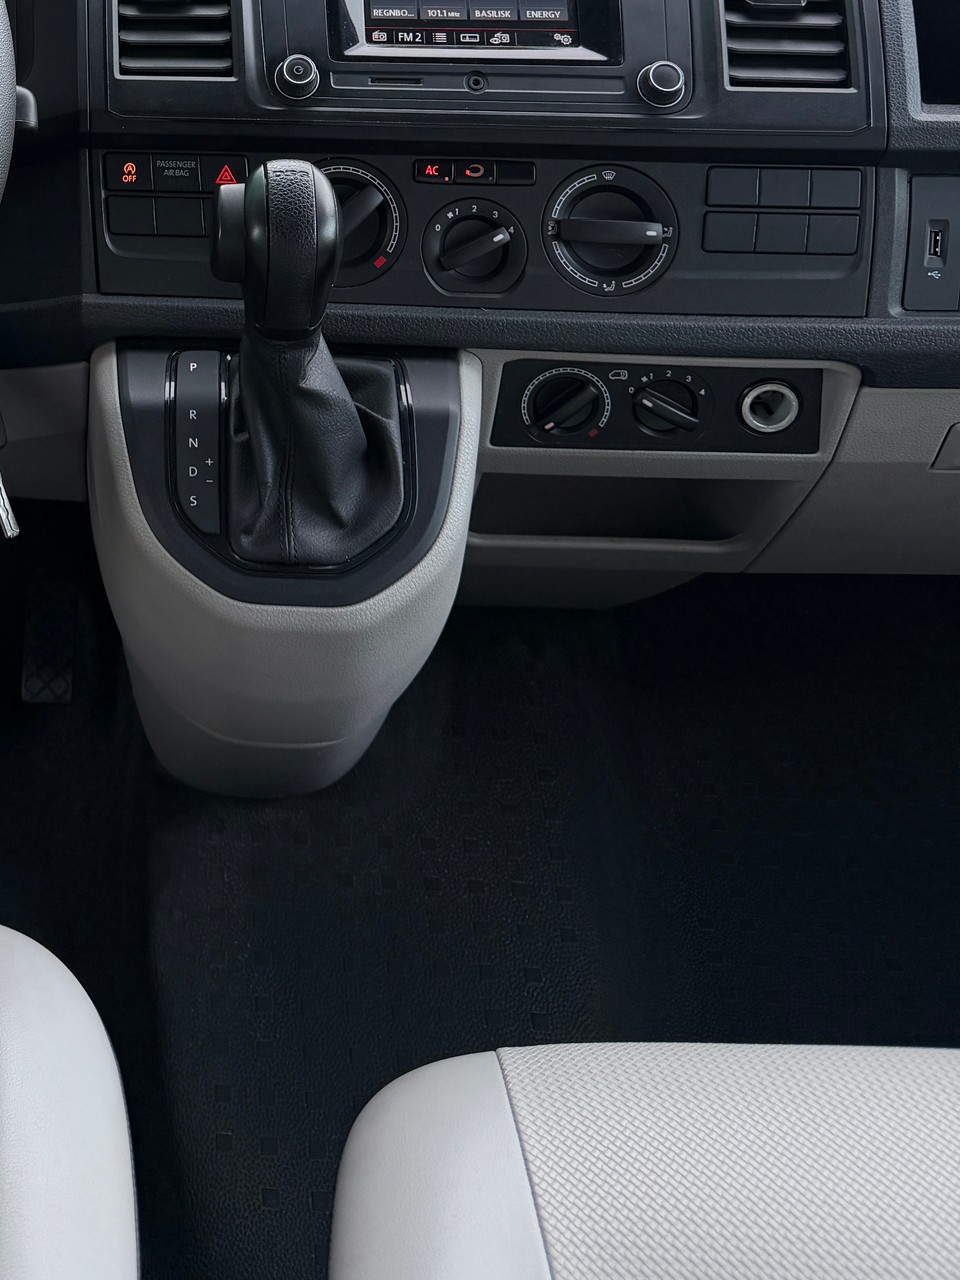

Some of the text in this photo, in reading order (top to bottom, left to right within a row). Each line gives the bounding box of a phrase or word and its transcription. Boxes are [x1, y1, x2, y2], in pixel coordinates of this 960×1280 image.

[427, 9, 447, 17] 101.1
[475, 9, 511, 18] BASILISK
[526, 10, 561, 19] ENERGY
[398, 32, 422, 42] FM 2
[156, 160, 196, 168] PASSENGER
[425, 165, 439, 175] AC
[122, 175, 137, 183] OFF
[471, 205, 478, 213] 2
[492, 211, 499, 219] 3
[508, 225, 515, 234] 4
[190, 362, 198, 372] P
[699, 388, 706, 396] 4
[189, 409, 197, 420] R
[188, 438, 199, 448] N
[188, 466, 198, 477] D
[189, 495, 198, 507] S
